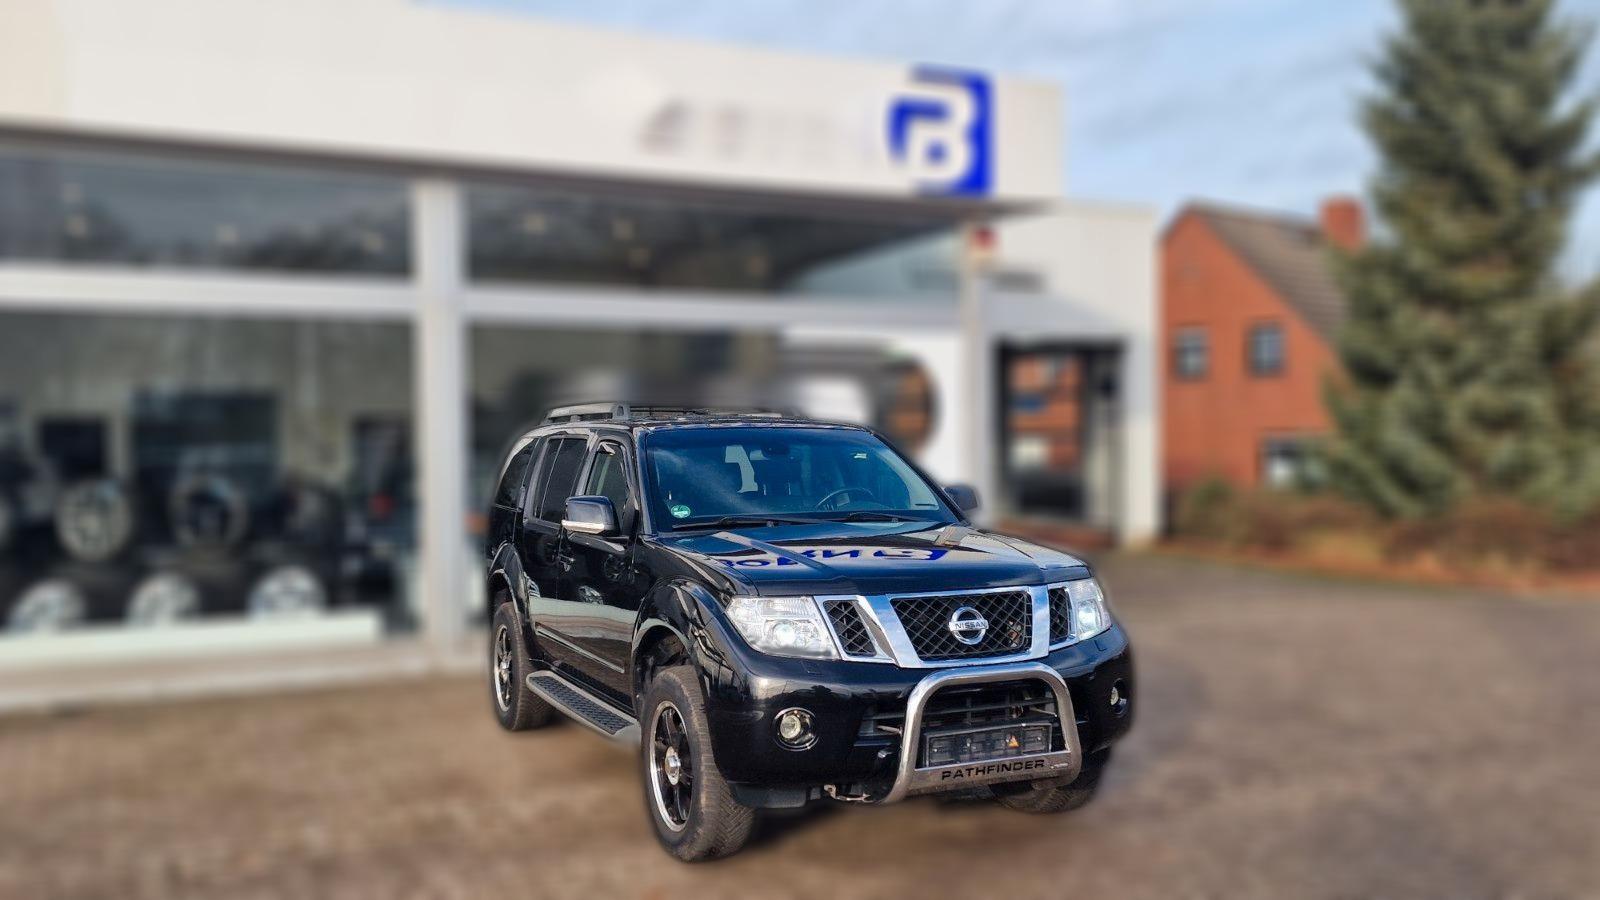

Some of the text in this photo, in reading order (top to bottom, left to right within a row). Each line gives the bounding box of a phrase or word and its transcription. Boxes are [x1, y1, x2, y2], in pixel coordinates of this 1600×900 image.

[887, 65, 996, 197] B
[955, 621, 986, 630] NISSAN
[941, 759, 1045, 780] PATHFINDER
